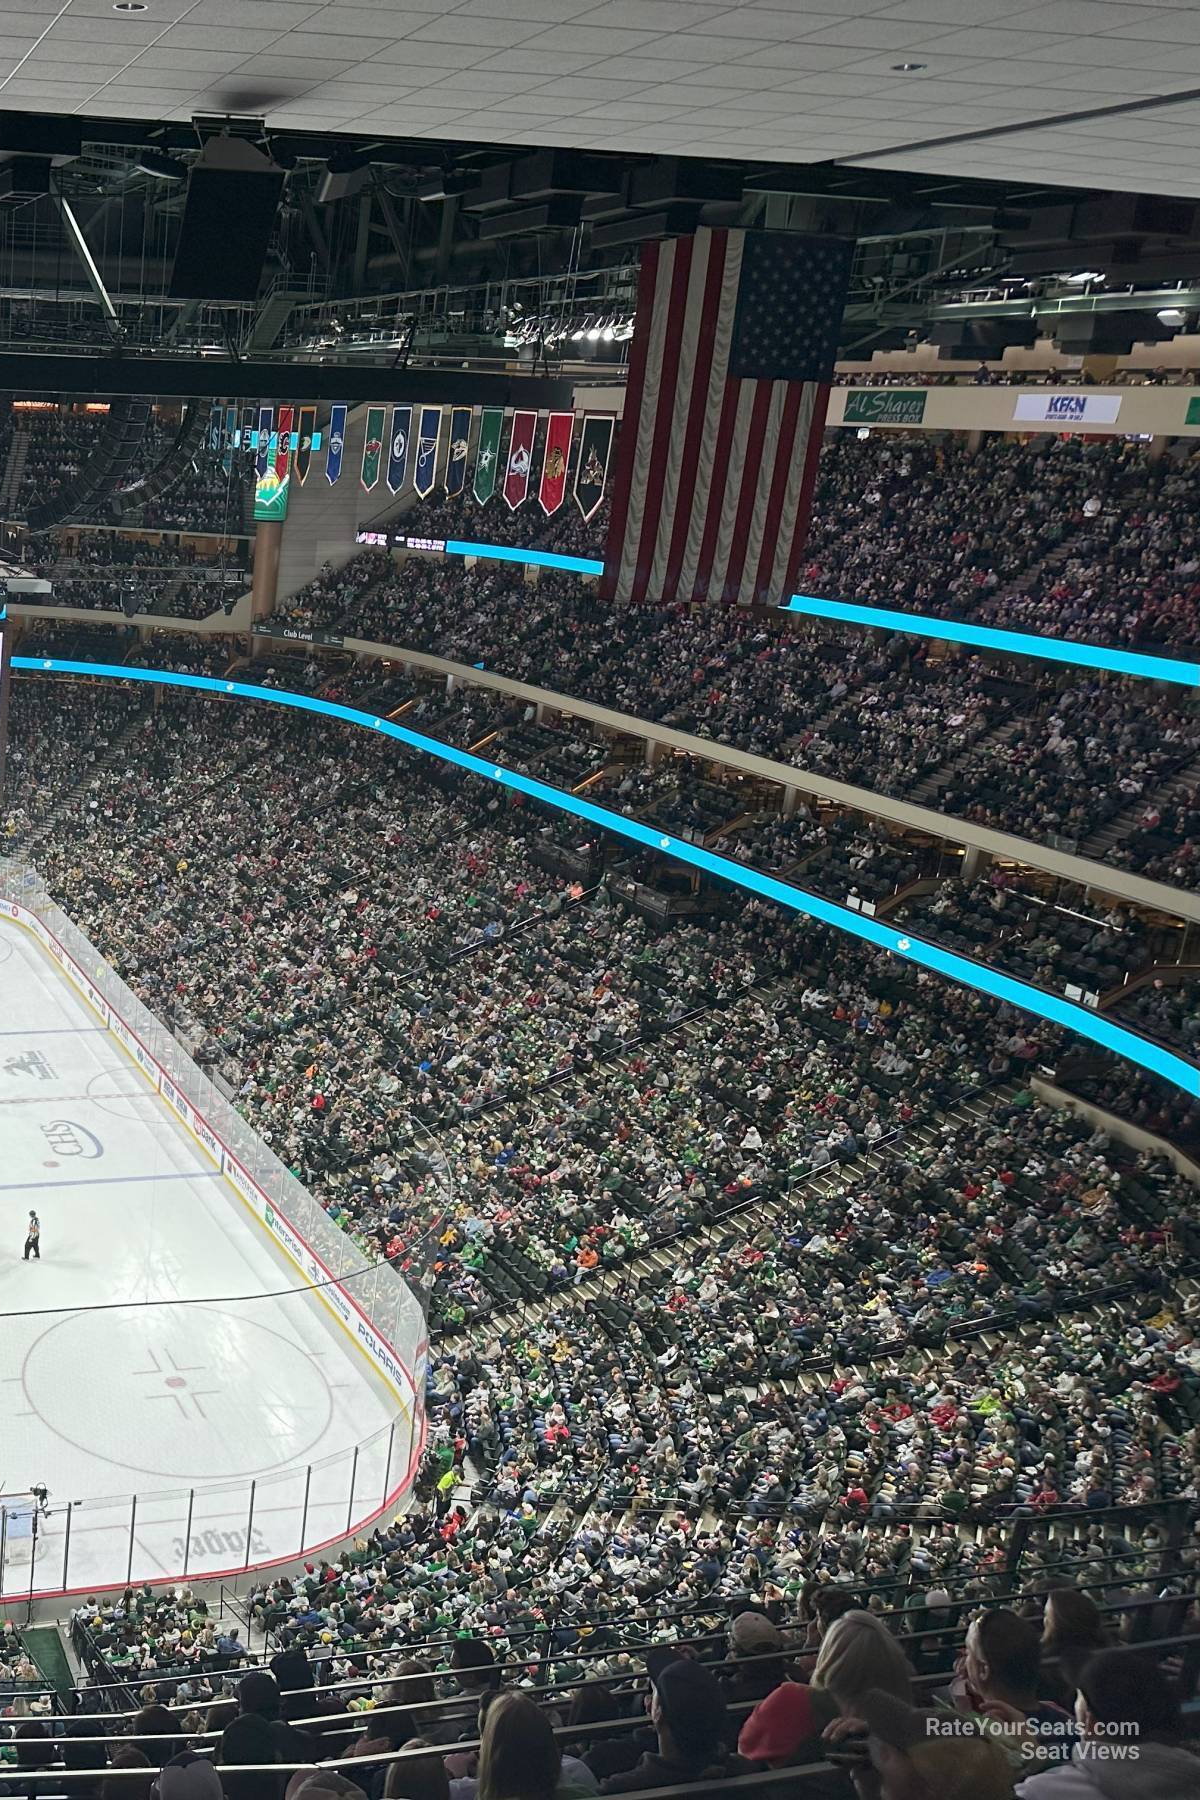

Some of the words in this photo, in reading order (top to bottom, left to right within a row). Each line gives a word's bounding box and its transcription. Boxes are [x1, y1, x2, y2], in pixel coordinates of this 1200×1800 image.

[844, 393, 867, 416] Al
[866, 392, 923, 416] Shaver
[877, 413, 901, 422] PRESS
[902, 414, 921, 423] BOX
[283, 629, 298, 638] Club
[298, 631, 313, 640] Level
[40, 1123, 84, 1156] CHS
[358, 1322, 402, 1386] POLARIS
